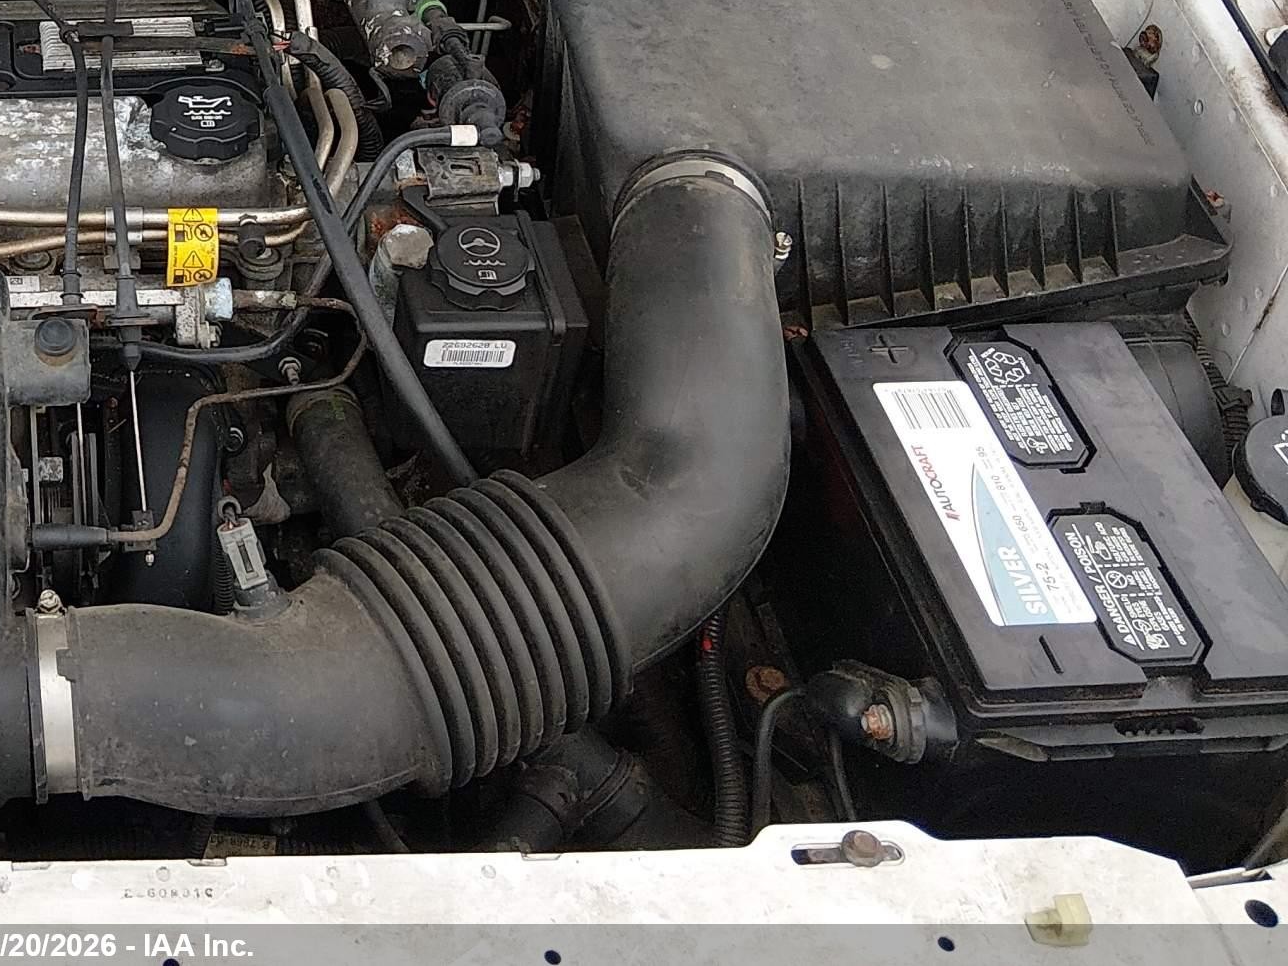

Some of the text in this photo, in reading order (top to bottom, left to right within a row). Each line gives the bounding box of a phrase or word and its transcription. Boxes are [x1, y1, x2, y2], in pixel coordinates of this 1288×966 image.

[976, 446, 985, 458] 95
[911, 445, 953, 513] AUTOCRAFT
[991, 475, 1005, 491] 810
[1012, 514, 1027, 532] 650
[1063, 531, 1096, 572] POISON
[998, 546, 1048, 616] SILVER
[1036, 562, 1060, 591] 75-2
[1125, 574, 1136, 584] NO
[1093, 584, 1130, 632] DANGER
[1130, 602, 1146, 617] EYES
[1152, 611, 1170, 630] GASES
